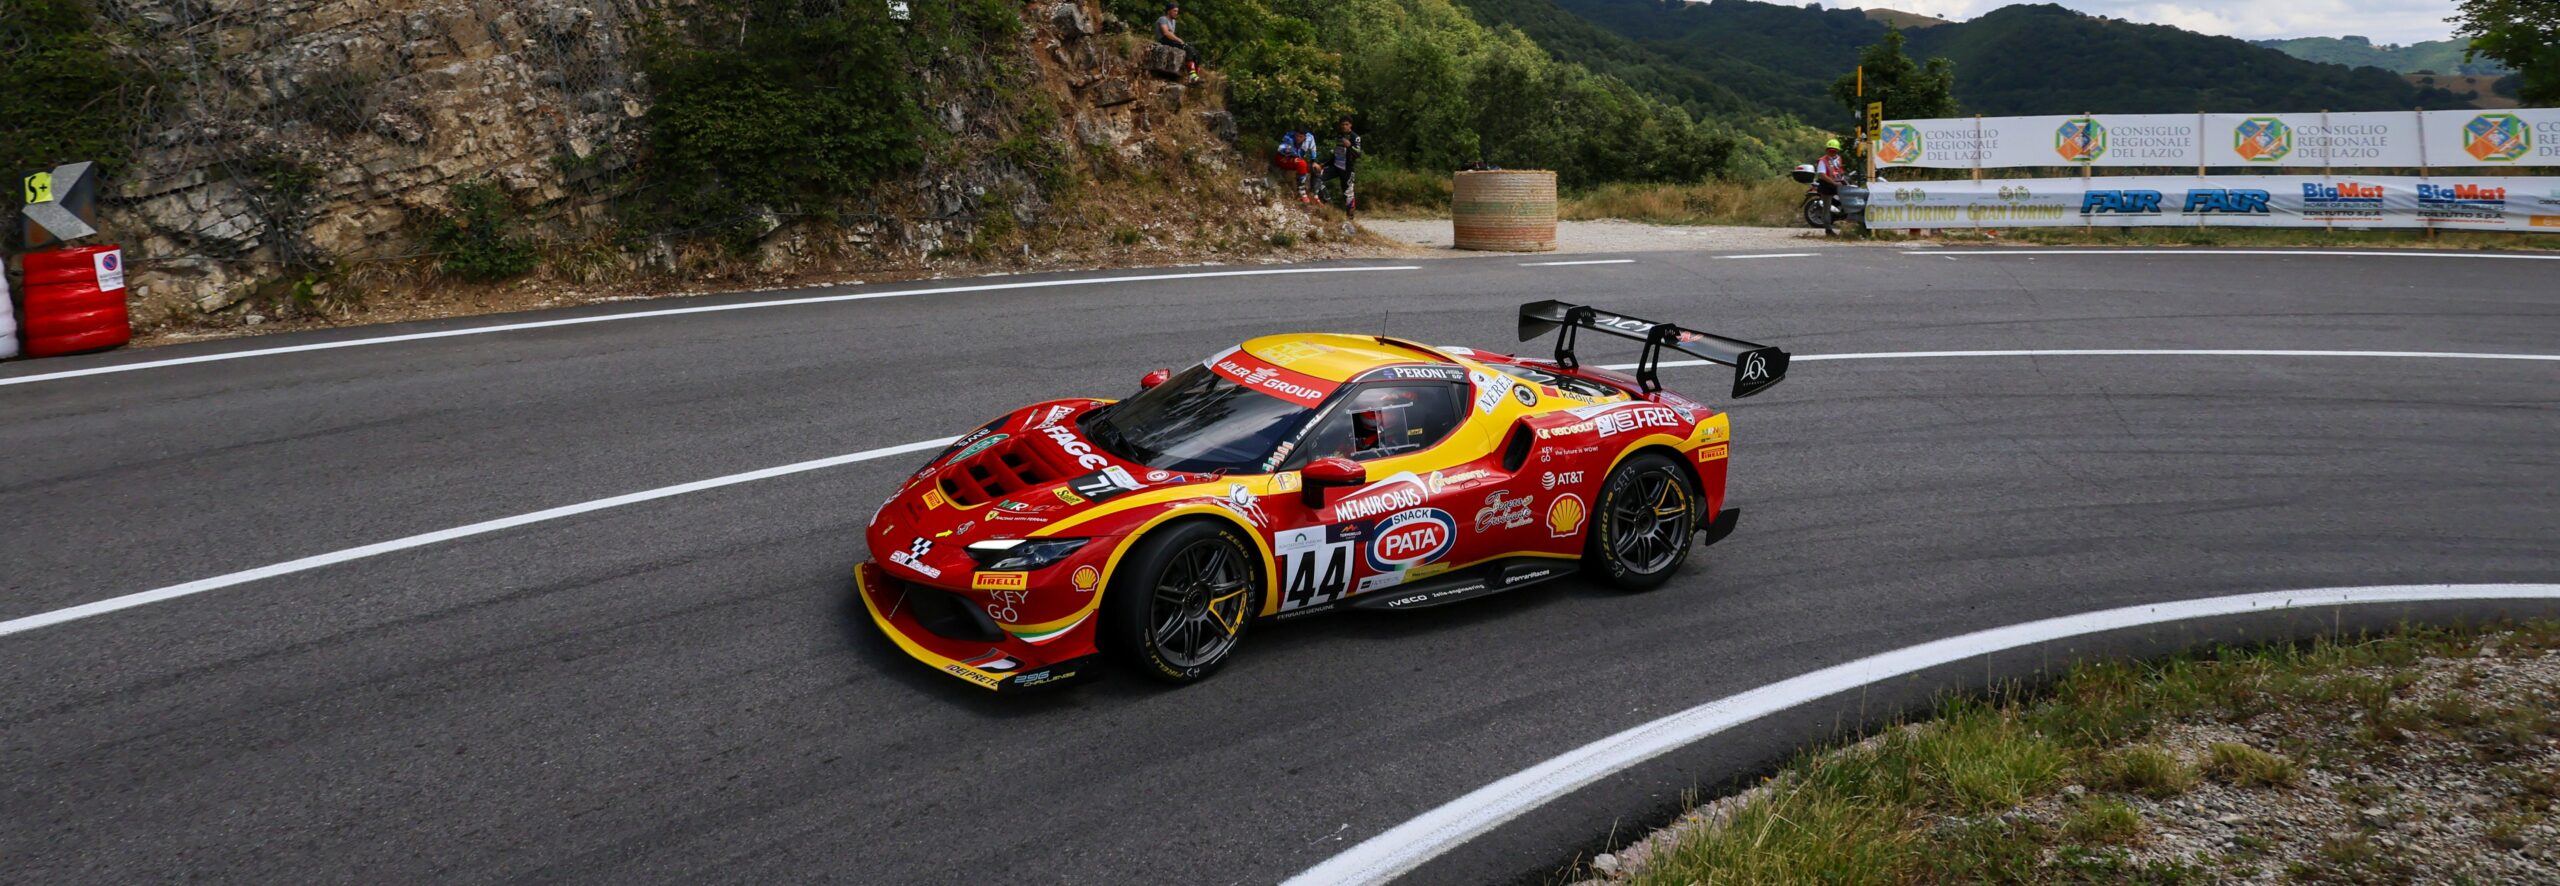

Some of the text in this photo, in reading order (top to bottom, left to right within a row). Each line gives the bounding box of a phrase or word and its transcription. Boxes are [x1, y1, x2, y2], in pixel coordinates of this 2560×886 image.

[1925, 129, 1999, 140] CONSIGLIO
[2111, 126, 2192, 137] CONSIGLIO
[2296, 124, 2388, 136] CONSIGLIO
[1926, 140, 1999, 150] REGIONALE
[2112, 138, 2192, 148] REGIONALE
[2297, 136, 2387, 147] REGIONALE
[1927, 150, 1992, 161] DEL LAZIO
[2112, 148, 2184, 159] DEL LAZIO
[2297, 147, 2379, 158] DEL LAZIO
[2302, 183, 2384, 202] BigMat
[2416, 183, 2505, 202] BigMat
[1866, 204, 1957, 222] GRAN TORINO
[1967, 202, 2063, 221] GRAN TORINO
[1393, 367, 1447, 378] PERONI
[1262, 377, 1322, 400] GROUP
[1480, 375, 1513, 411] NEREA
[1043, 426, 1108, 470] FAGE
[1557, 471, 1584, 485] AT&T
[1335, 488, 1421, 522] METAUROBUS
[1393, 510, 1430, 525] SNACK
[1385, 527, 1437, 557] PATA
[977, 574, 1022, 585] PIRELLI
[1287, 546, 1345, 607] 44
[990, 589, 1028, 608] KEY
[1388, 595, 1427, 607] IVECO
[988, 604, 1018, 622] GO
[1305, 604, 1334, 614] GENUINE
[1014, 671, 1050, 683] 296
[1023, 671, 1076, 687] CHALLENGE
